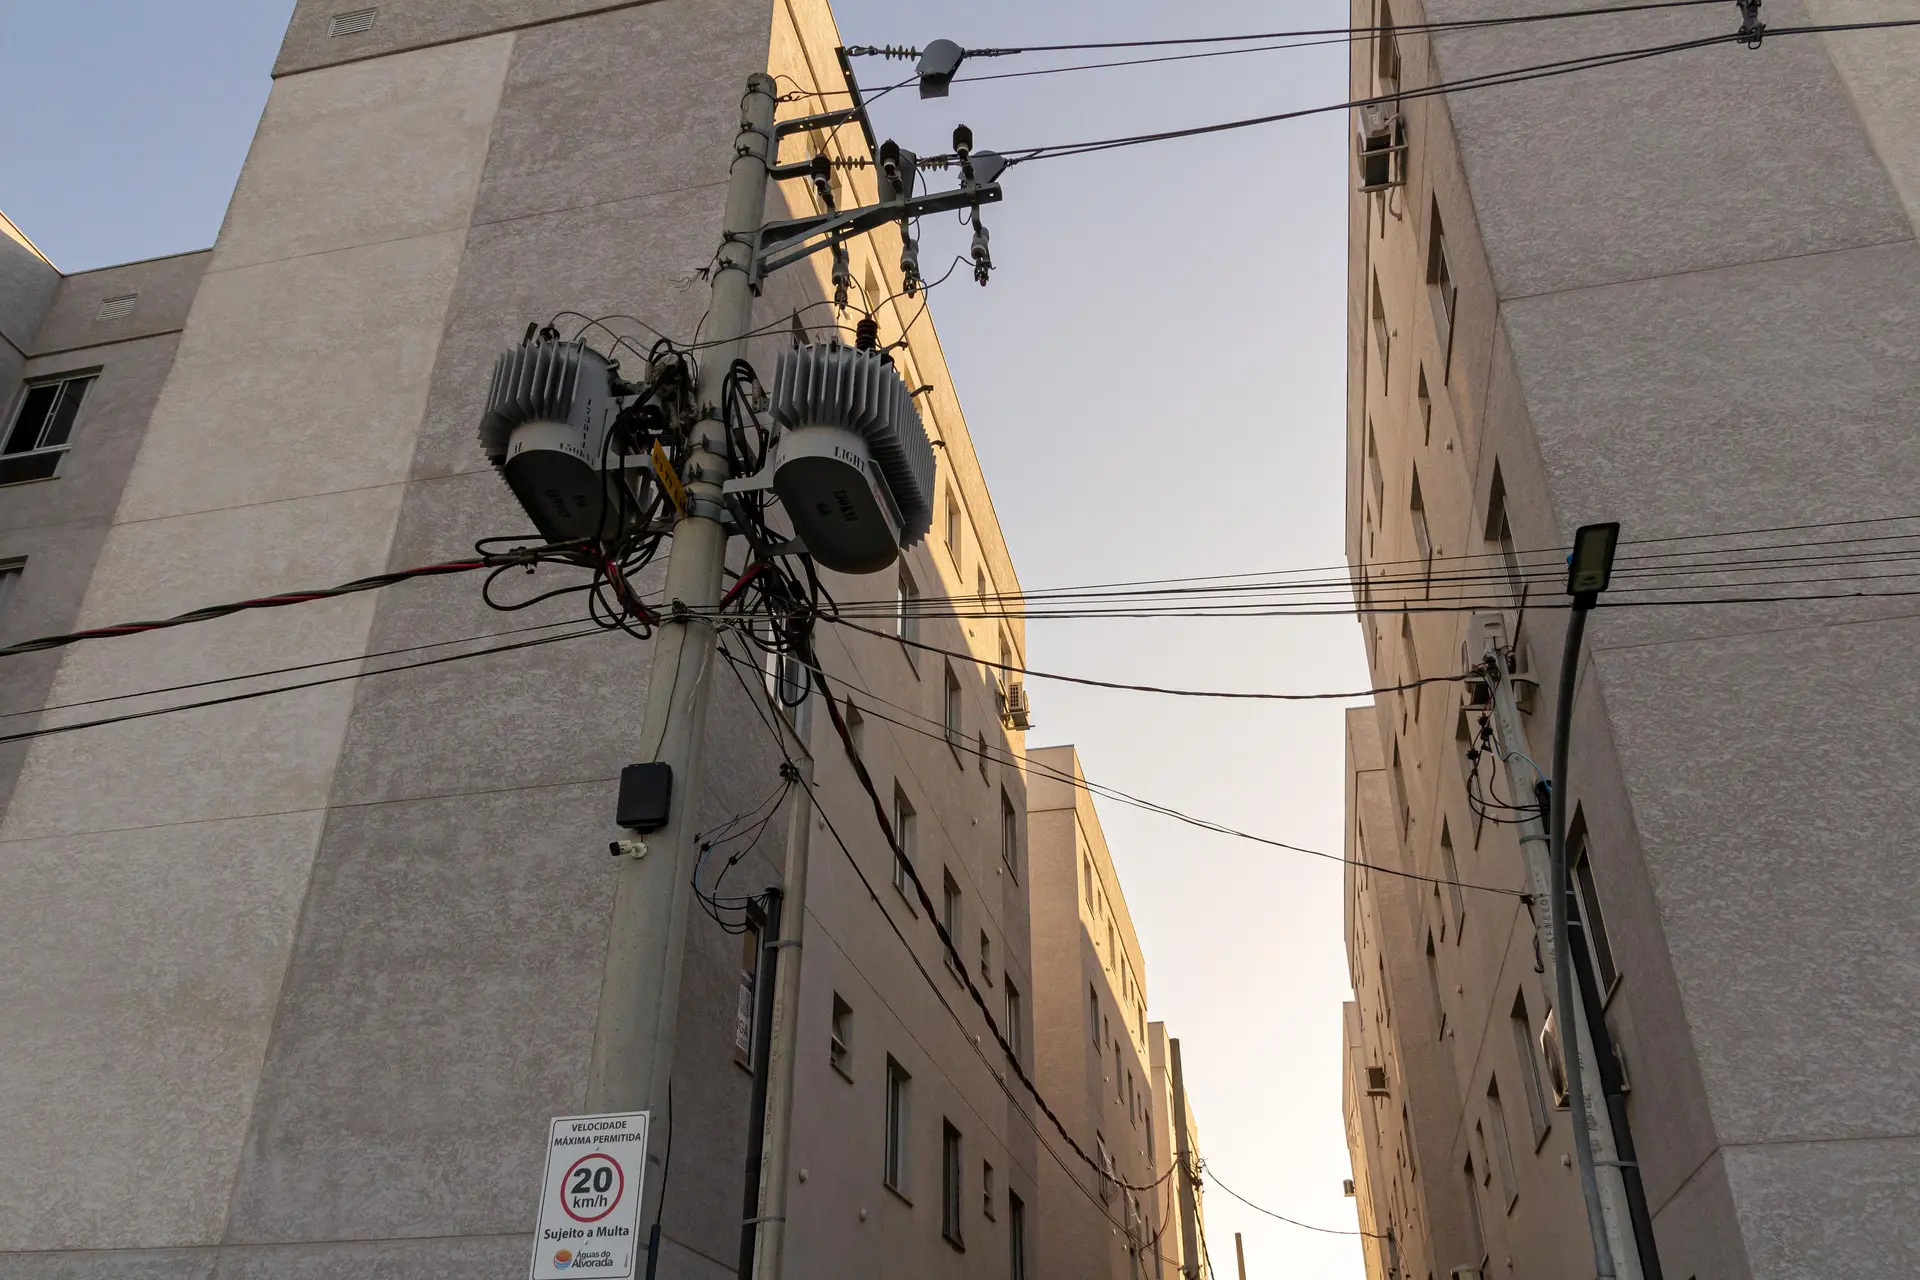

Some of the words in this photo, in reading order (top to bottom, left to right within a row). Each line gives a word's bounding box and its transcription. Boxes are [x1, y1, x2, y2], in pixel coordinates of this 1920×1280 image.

[834, 446, 867, 473] LIGHT
[571, 1120, 627, 1132] VELOCIDADE
[554, 1134, 591, 1146] MÁXIMA
[593, 1132, 641, 1144] PERMITIDA
[571, 1166, 613, 1194] 20
[573, 1194, 608, 1208] km/h
[544, 1227, 584, 1241] Sujeito
[586, 1229, 594, 1238] a
[596, 1225, 630, 1238] Multa
[576, 1249, 600, 1260] Águas
[600, 1249, 611, 1258] do
[571, 1257, 613, 1268] Alvorada
